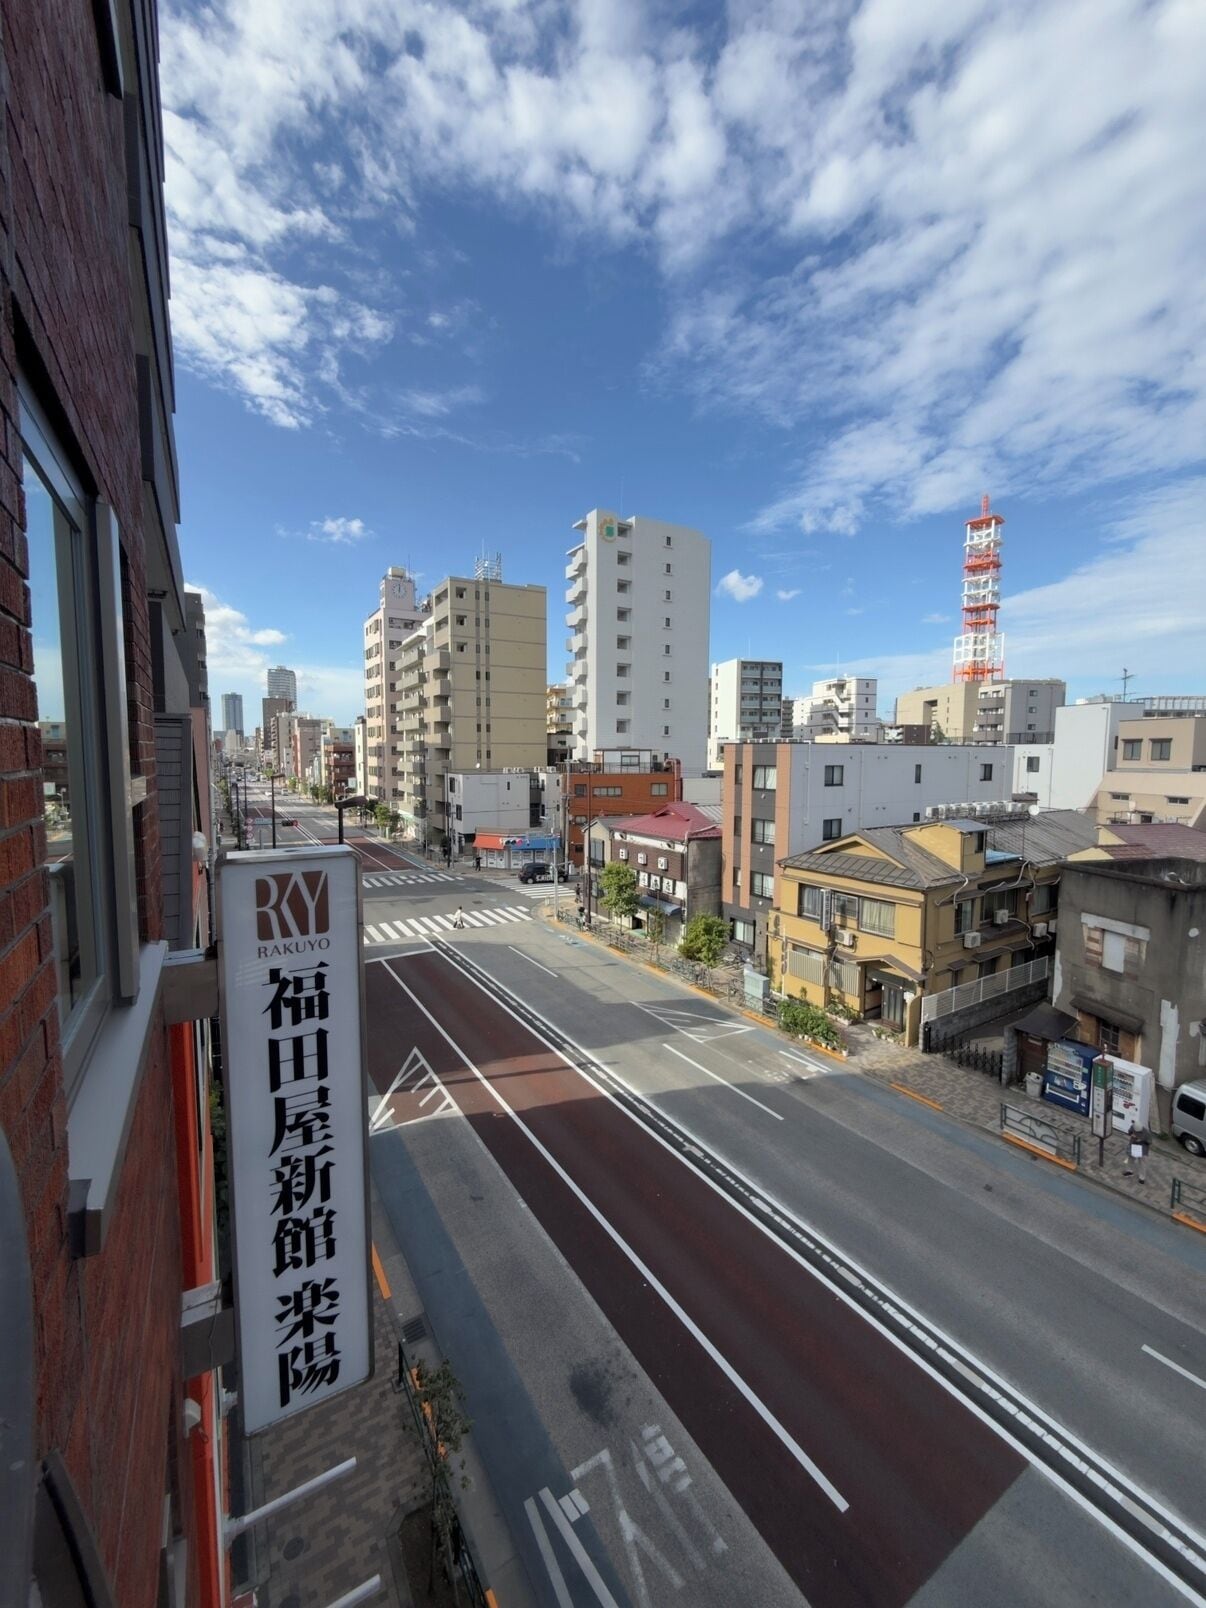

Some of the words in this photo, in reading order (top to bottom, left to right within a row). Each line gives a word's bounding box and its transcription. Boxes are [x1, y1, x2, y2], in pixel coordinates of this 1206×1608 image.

[257, 937, 330, 959] RAKUYO
[262, 961, 338, 1277] 福田屋新館
[275, 1277, 341, 1408] 楽陽
